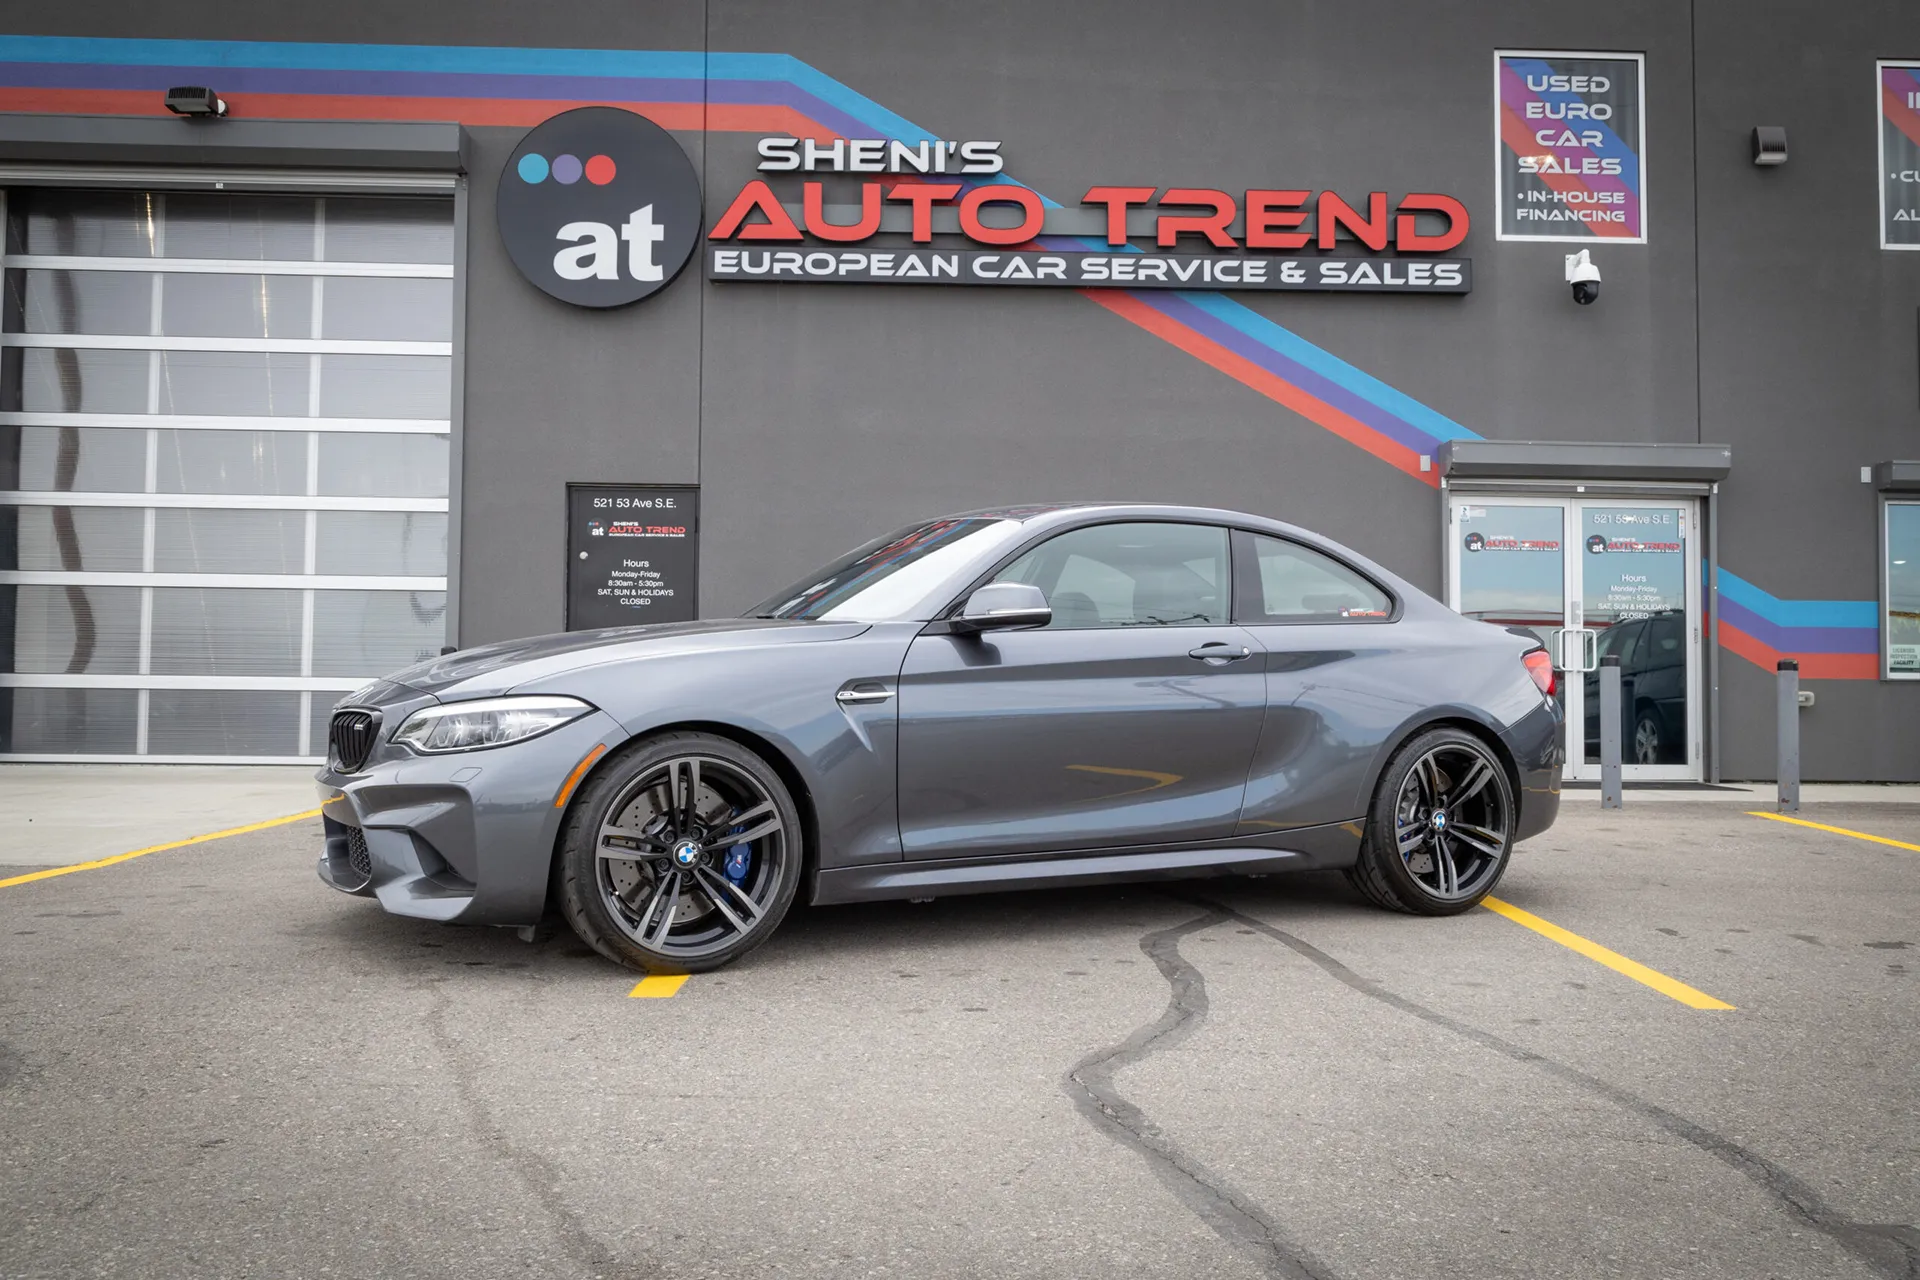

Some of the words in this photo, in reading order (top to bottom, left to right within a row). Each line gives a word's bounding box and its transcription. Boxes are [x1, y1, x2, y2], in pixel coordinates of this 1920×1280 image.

[1526, 75, 1611, 93] USED
[1525, 102, 1613, 121] EURO
[1535, 129, 1604, 148] CAR
[757, 137, 1004, 174] SHENI'S
[1517, 156, 1623, 175] SALES
[708, 179, 1046, 246] AUTO
[1080, 185, 1471, 252] TREND
[1516, 208, 1626, 222] FINANCING
[553, 203, 665, 282] at
[713, 249, 959, 278] EUROPEAN
[972, 254, 1067, 281] CAR
[1080, 257, 1269, 284] SERVICE
[1280, 260, 1307, 284] &
[1318, 261, 1464, 286] SALES
[593, 498, 613, 508] 521
[616, 498, 630, 508] 53
[632, 498, 653, 508] Ave
[655, 498, 677, 508] S.E.
[1593, 514, 1612, 524] 521
[1630, 514, 1650, 524] Ave
[592, 527, 605, 536] at
[646, 526, 686, 534] TREND
[1470, 542, 1482, 550] at
[1592, 543, 1604, 552] at
[623, 559, 650, 568] Hours
[611, 571, 661, 579] Monday-Friday
[1621, 574, 1647, 582] Hours
[638, 580, 664, 588] 5:30pm
